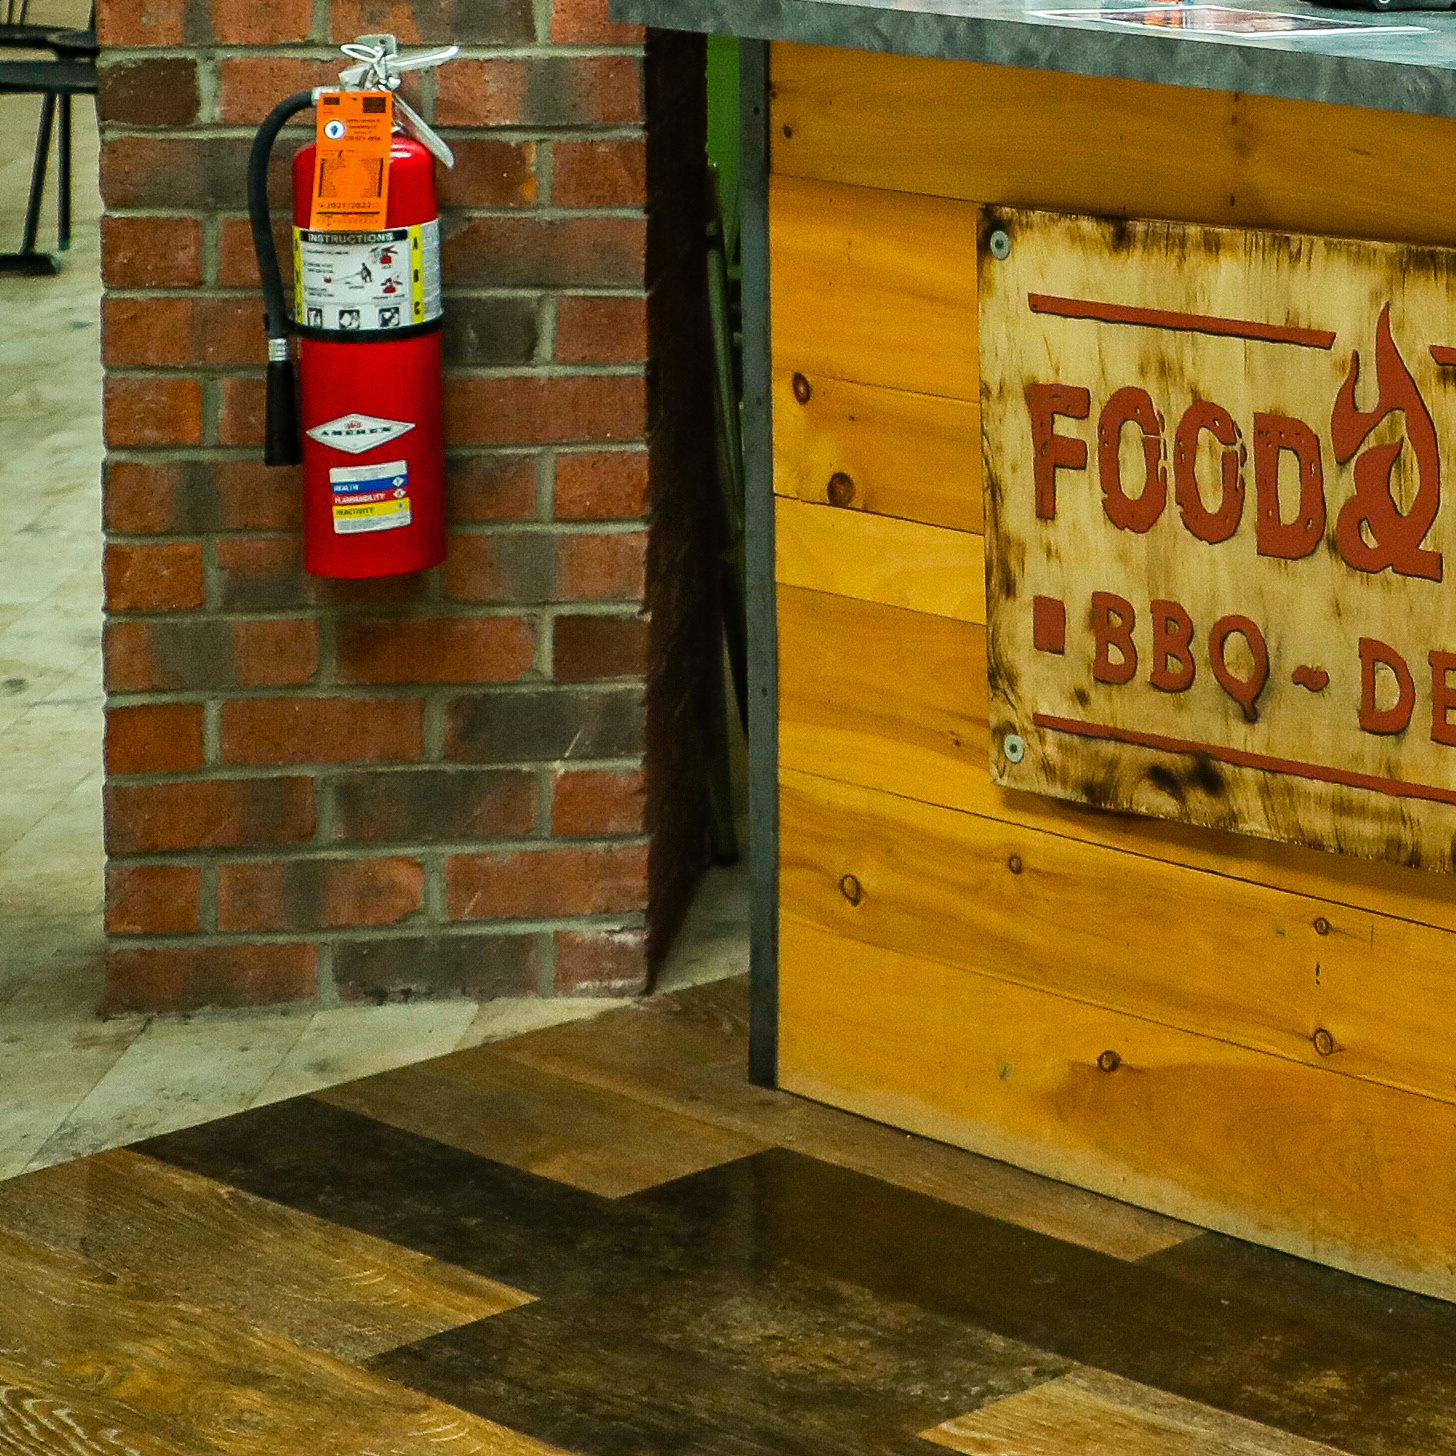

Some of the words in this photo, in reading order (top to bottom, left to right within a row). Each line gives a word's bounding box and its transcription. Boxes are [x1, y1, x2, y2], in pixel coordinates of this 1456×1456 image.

[308, 232, 394, 244] INSTRUCTIONS
[1025, 382, 1328, 560] FOOD
[1091, 590, 1269, 723] BBQ
